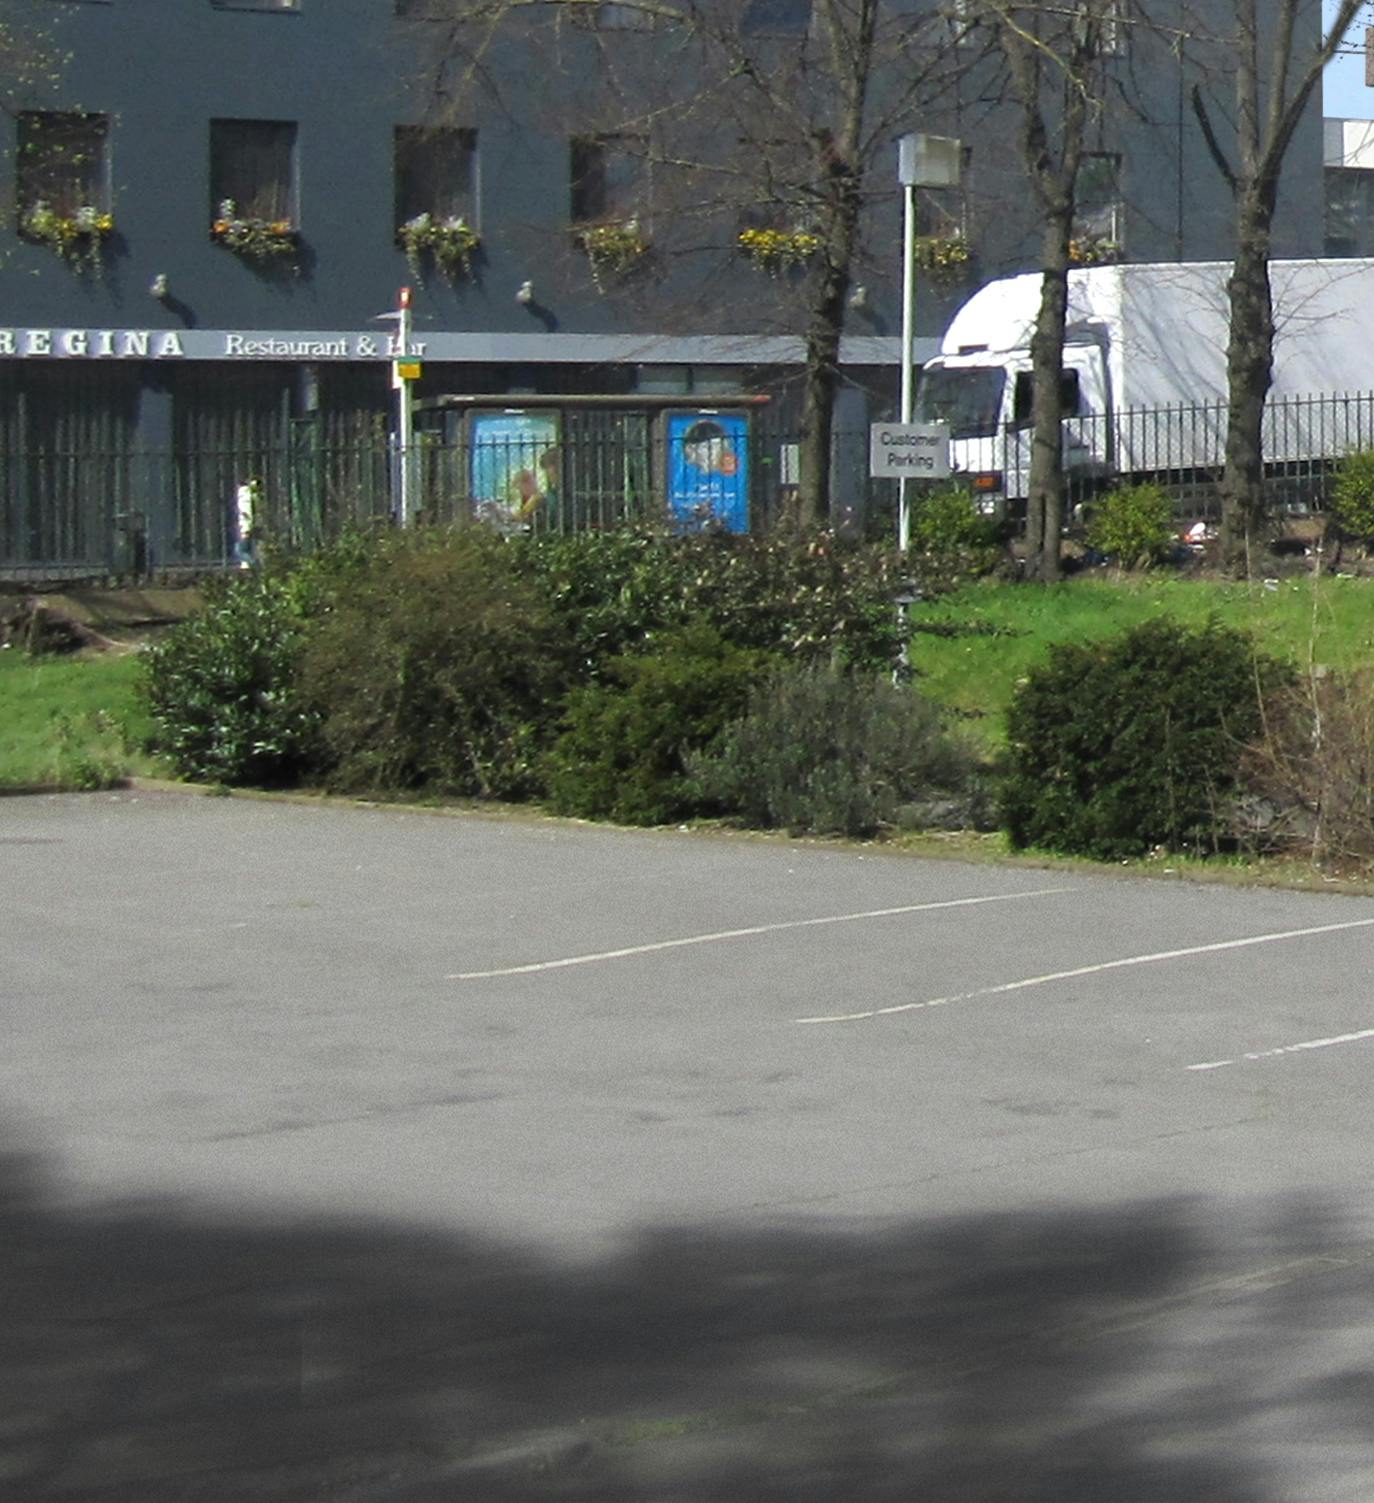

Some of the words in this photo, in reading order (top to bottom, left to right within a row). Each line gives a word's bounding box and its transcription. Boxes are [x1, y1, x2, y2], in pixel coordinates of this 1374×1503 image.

[225, 334, 348, 356] Restaurant
[356, 335, 377, 357] &
[881, 431, 941, 447] Customer
[887, 452, 934, 470] Parking
